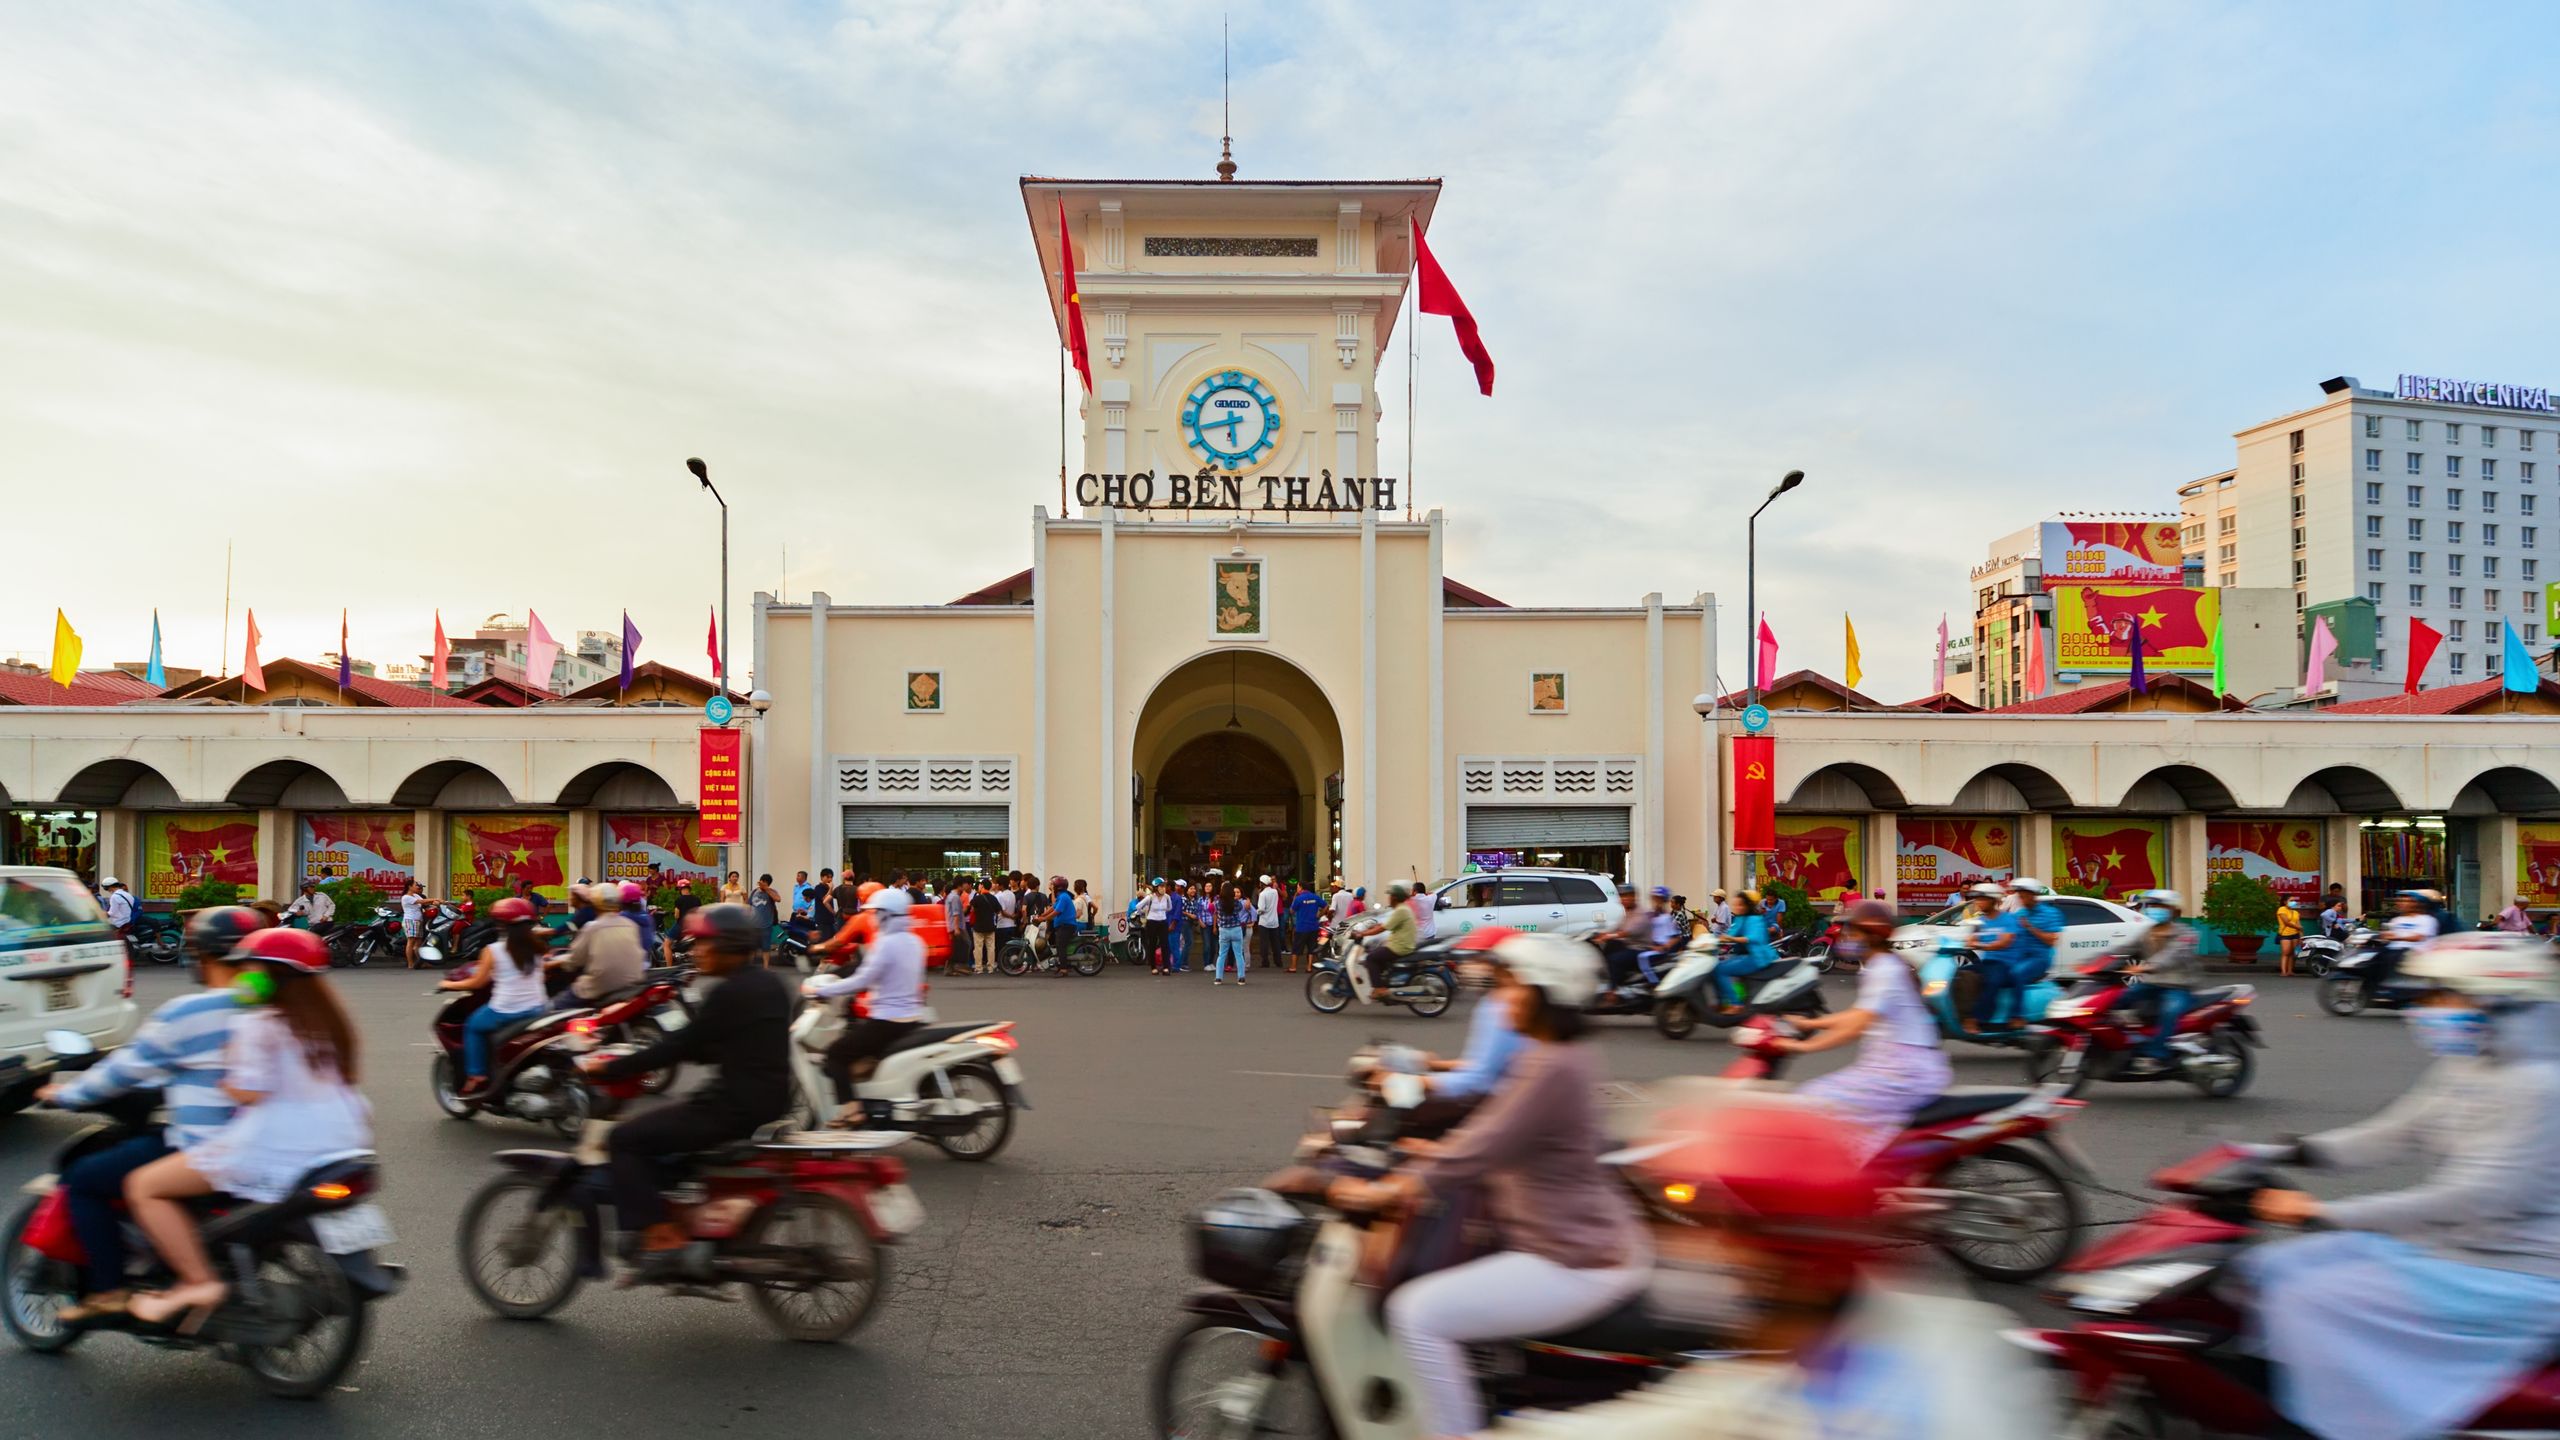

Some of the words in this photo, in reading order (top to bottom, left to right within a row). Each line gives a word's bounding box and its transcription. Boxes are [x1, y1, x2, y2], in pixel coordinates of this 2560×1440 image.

[1222, 371, 1243, 387] 12
[2399, 373, 2471, 402] LIBERTY
[2473, 382, 2556, 411] CENTRAL
[1075, 469, 1155, 511] CHỢ
[1168, 464, 1242, 509] BẾN
[1257, 468, 1397, 510] THÀNH
